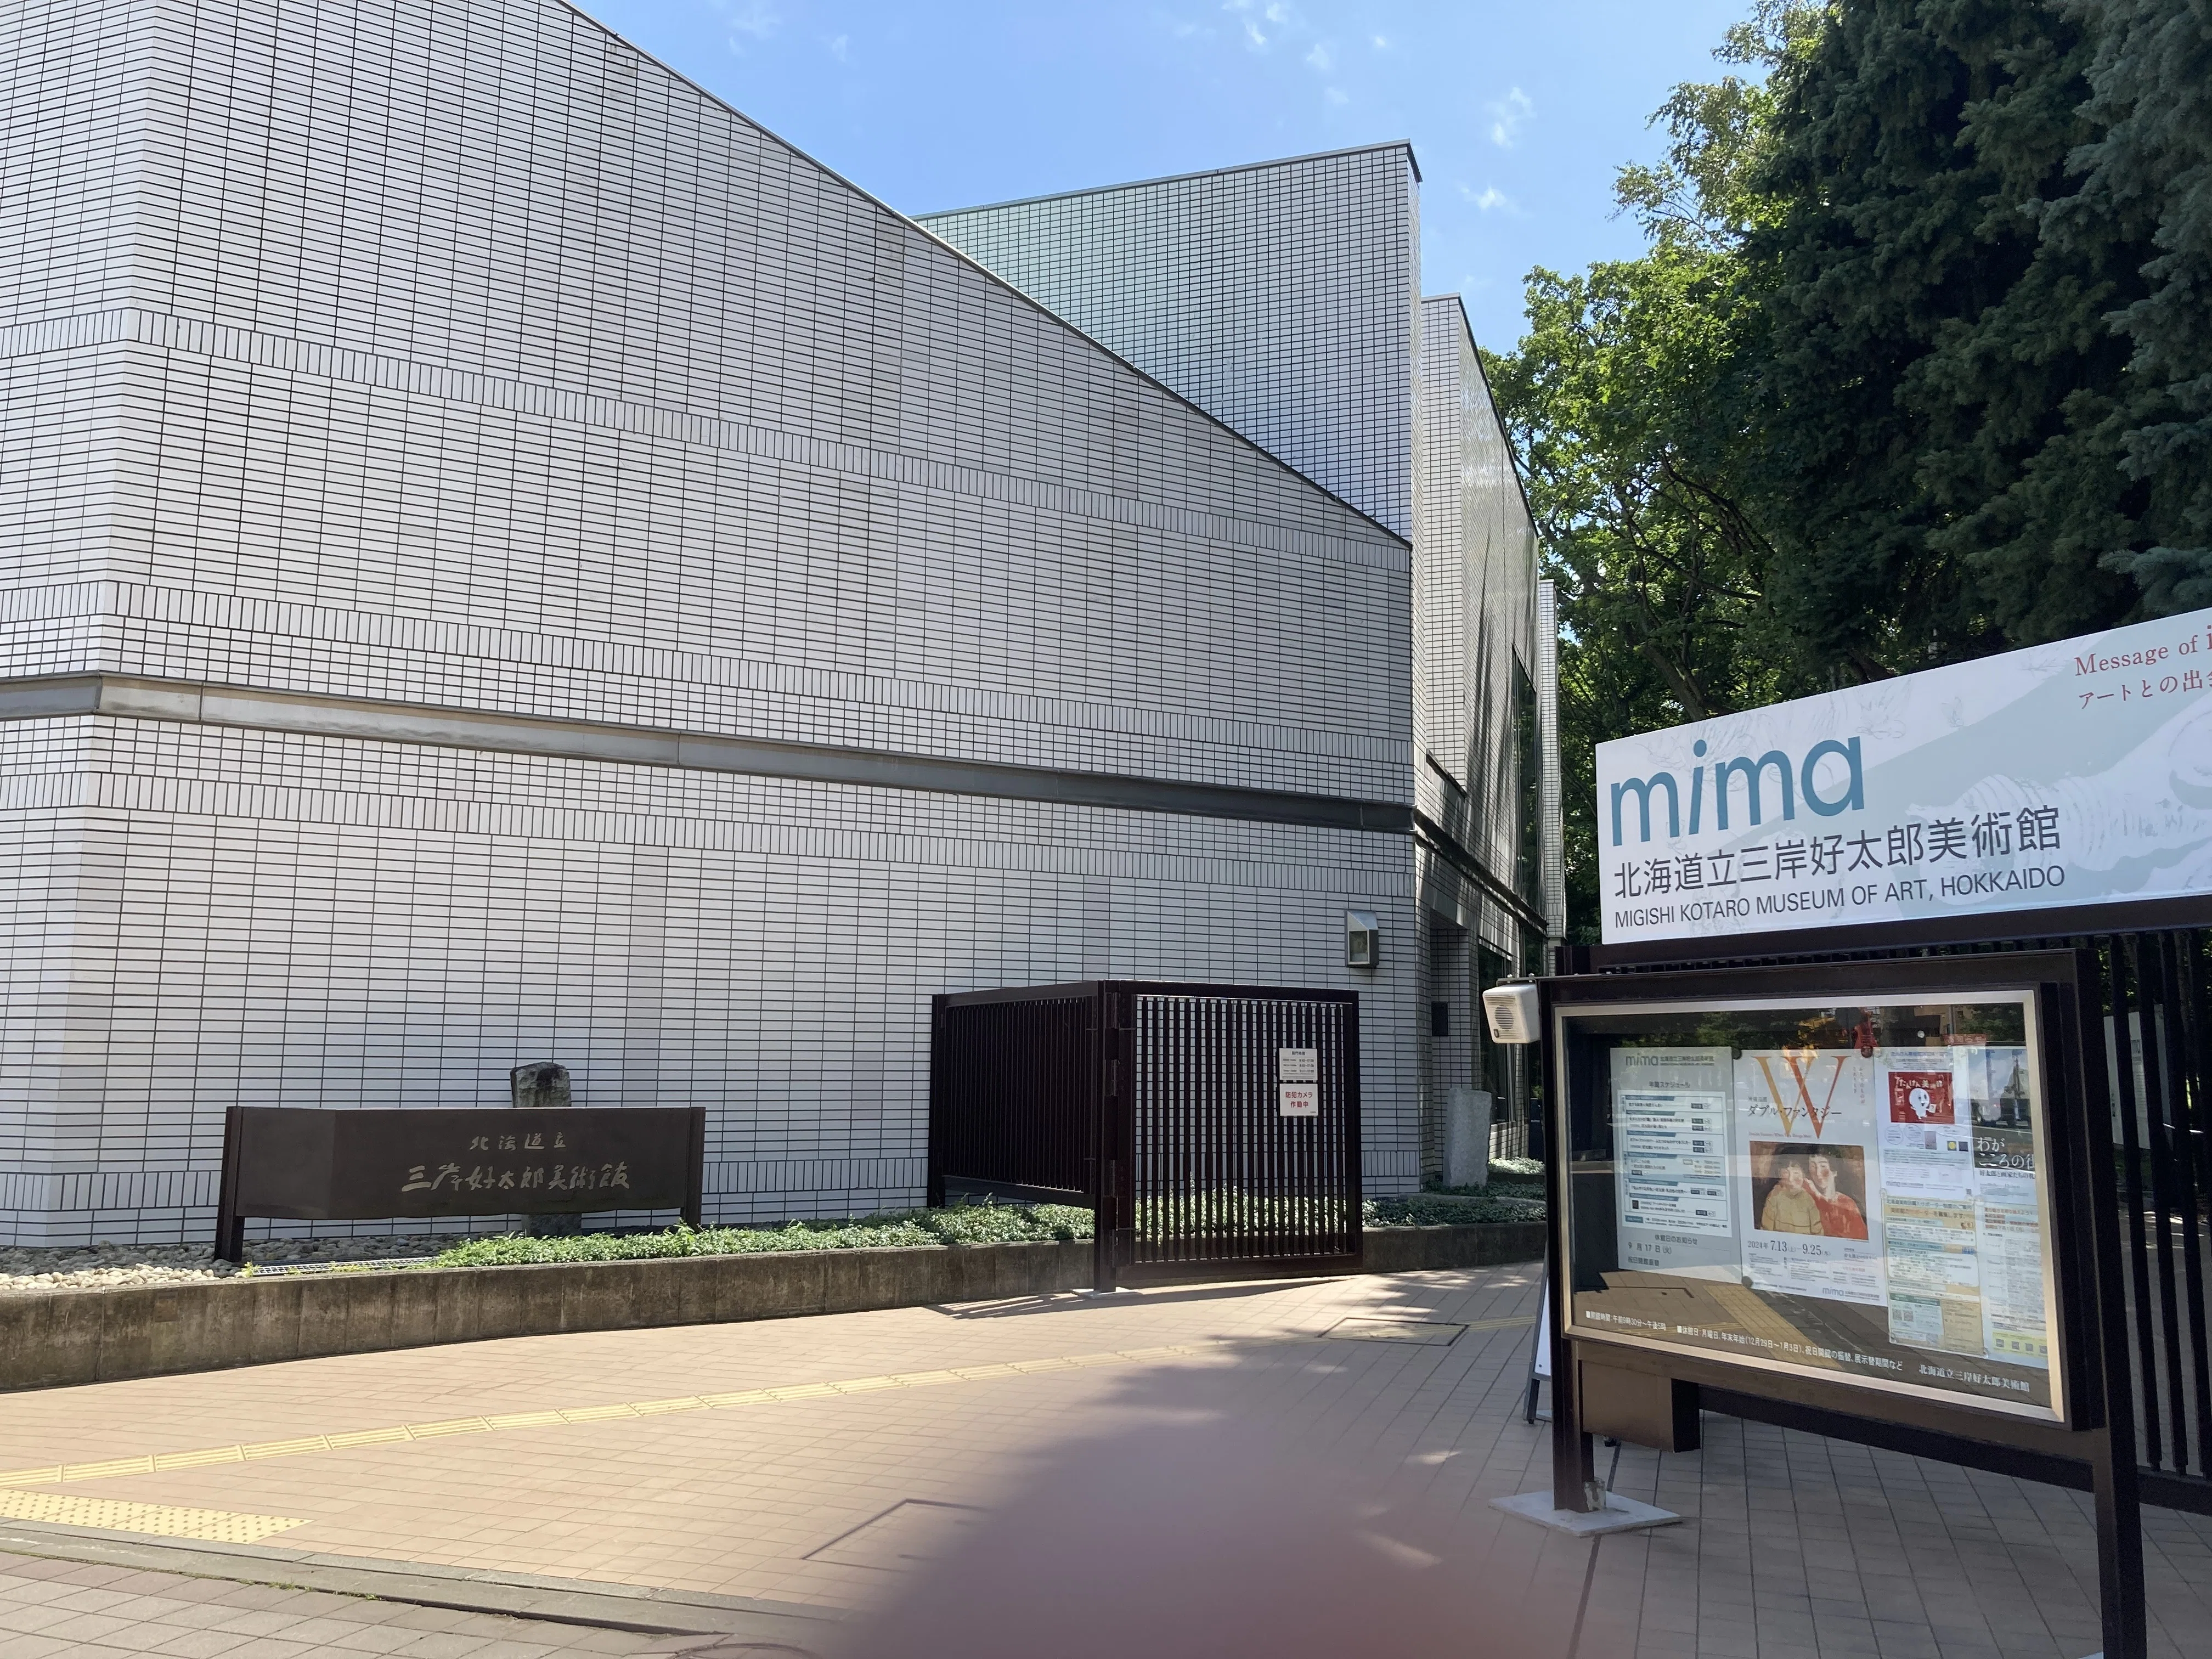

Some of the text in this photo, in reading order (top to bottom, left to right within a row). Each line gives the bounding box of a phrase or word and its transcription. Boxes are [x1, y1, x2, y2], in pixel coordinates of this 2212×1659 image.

[2074, 646, 2169, 676] Message
[2179, 634, 2198, 655] of
[1611, 736, 1865, 847] mima
[1614, 805, 2061, 899] 北海道立三岸好太郎美術館
[1615, 866, 2065, 928] MIGISHI KOTARO MUSEUM OF ART, HOKKAIDO
[1626, 1053, 1658, 1066] mima
[1748, 1104, 1842, 1118] ダブル・ファンタジー
[470, 1132, 567, 1151] 北海道立
[1977, 1137, 2005, 1152] わが
[1655, 1234, 1698, 1245] 休館日のお知らせ
[1747, 1240, 1768, 1250] 2024年
[1919, 1364, 2030, 1392] 北海道立三岸好太郎美術館
